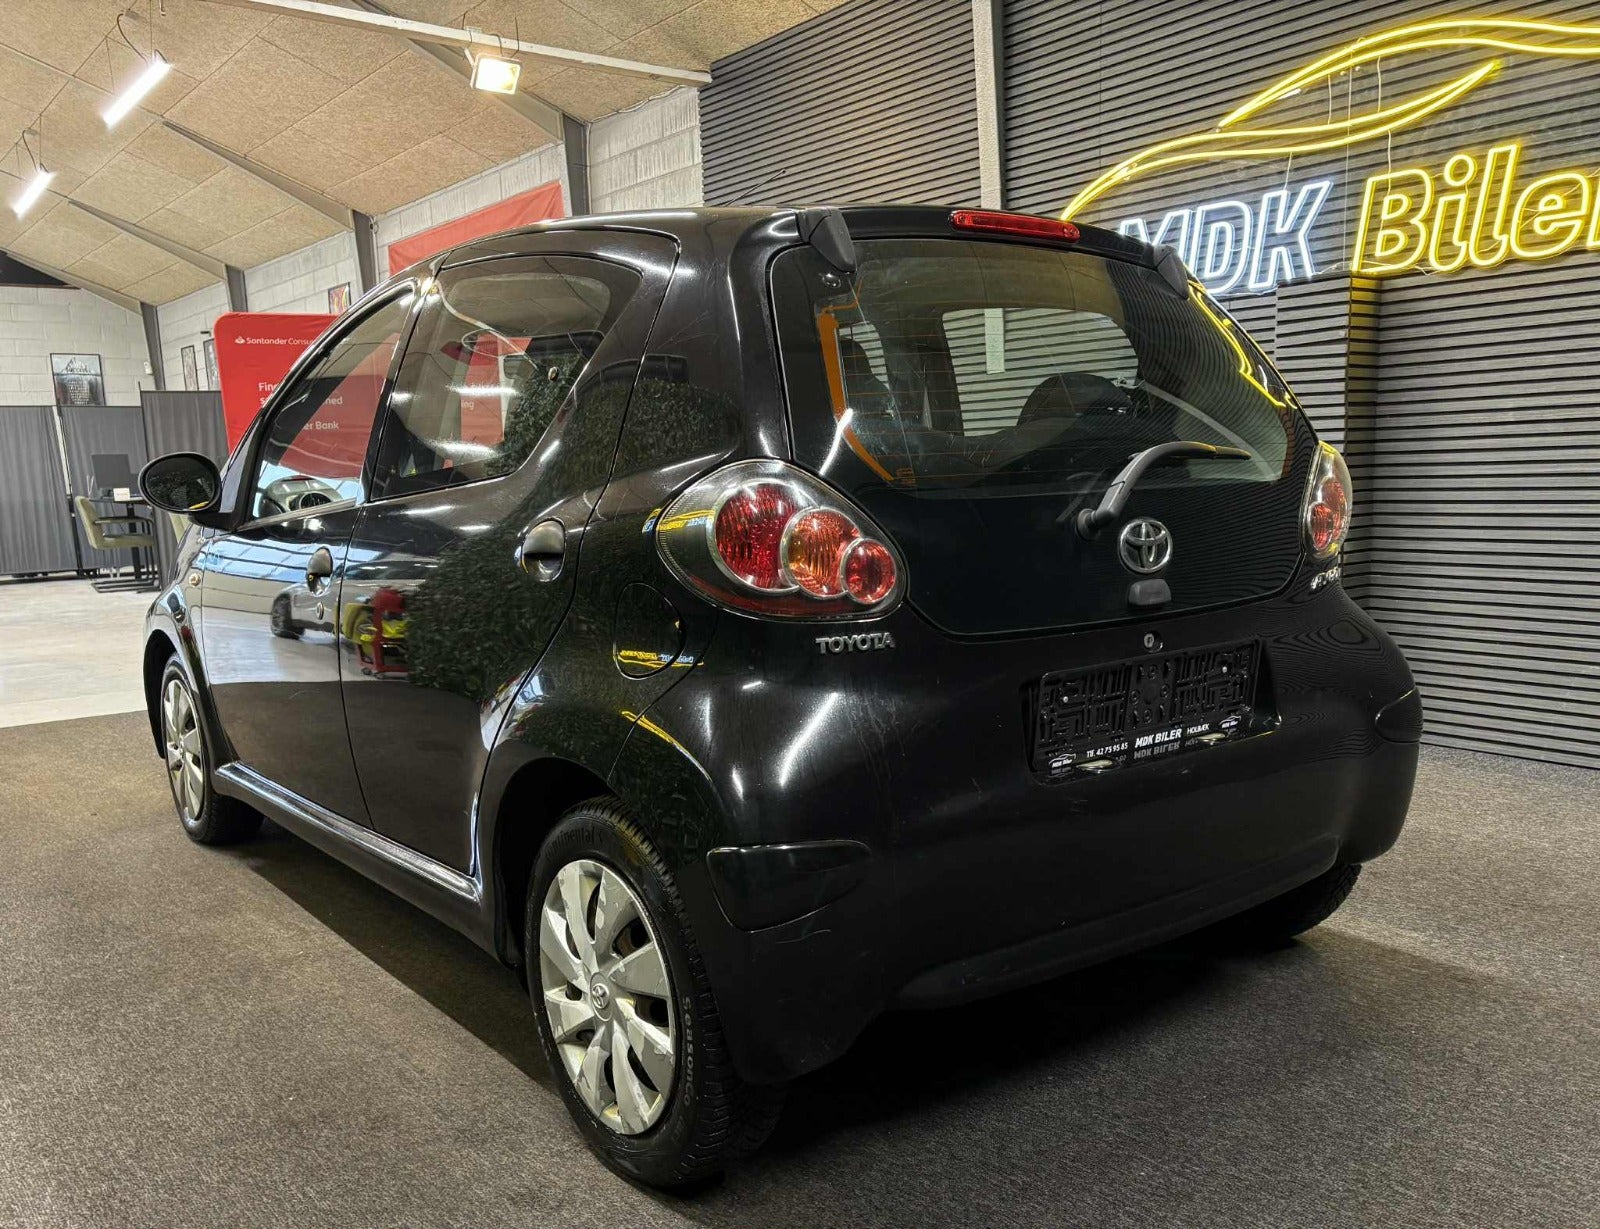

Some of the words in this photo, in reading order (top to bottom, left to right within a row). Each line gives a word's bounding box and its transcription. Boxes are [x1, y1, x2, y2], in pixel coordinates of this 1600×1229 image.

[1117, 179, 1334, 295] MDK
[246, 335, 287, 345] Santander
[315, 420, 339, 430] Bank
[815, 632, 896, 654] TOYOTA
[1134, 733, 1155, 749] MDK
[1154, 728, 1183, 744] BILER
